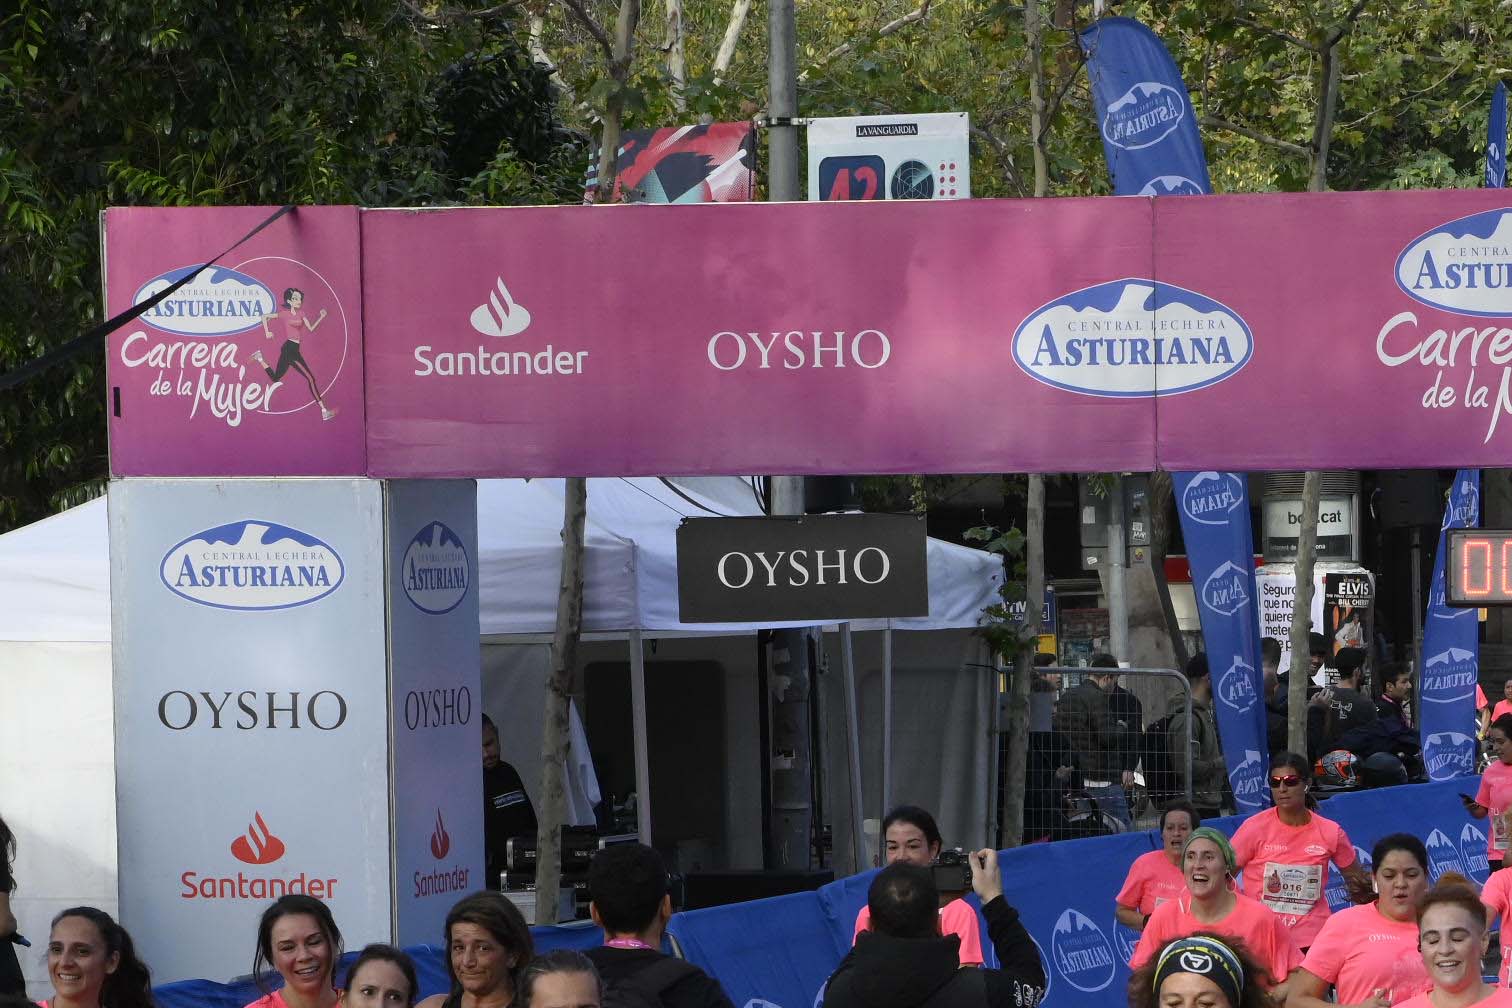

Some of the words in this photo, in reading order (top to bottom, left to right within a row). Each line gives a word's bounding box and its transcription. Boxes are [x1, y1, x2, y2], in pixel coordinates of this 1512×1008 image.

[169, 288, 211, 297] ENTRAL
[1067, 319, 1143, 332] CENTRAL
[1150, 318, 1228, 331] LECHERA
[121, 331, 239, 369] Carrera
[414, 344, 589, 376] Santander
[707, 330, 891, 371] OYSHO
[1031, 323, 1235, 367] ASTURIANA
[150, 370, 172, 396] de
[177, 368, 193, 396] la
[190, 366, 283, 427] Mujer
[1422, 368, 1456, 409] de
[1464, 368, 1489, 408] la
[175, 554, 330, 588] ASTURIANA
[203, 551, 259, 561] CENTRAL
[265, 551, 325, 561] LECHERA
[718, 547, 891, 589] OYSHO
[408, 556, 465, 591] ASTURIANA
[1338, 582, 1369, 595] ELVIS
[1264, 600, 1280, 612] que
[158, 690, 348, 731] OYSHO
[405, 686, 471, 731] OYSHO
[181, 871, 338, 899] Santander
[414, 865, 470, 898] Santander
